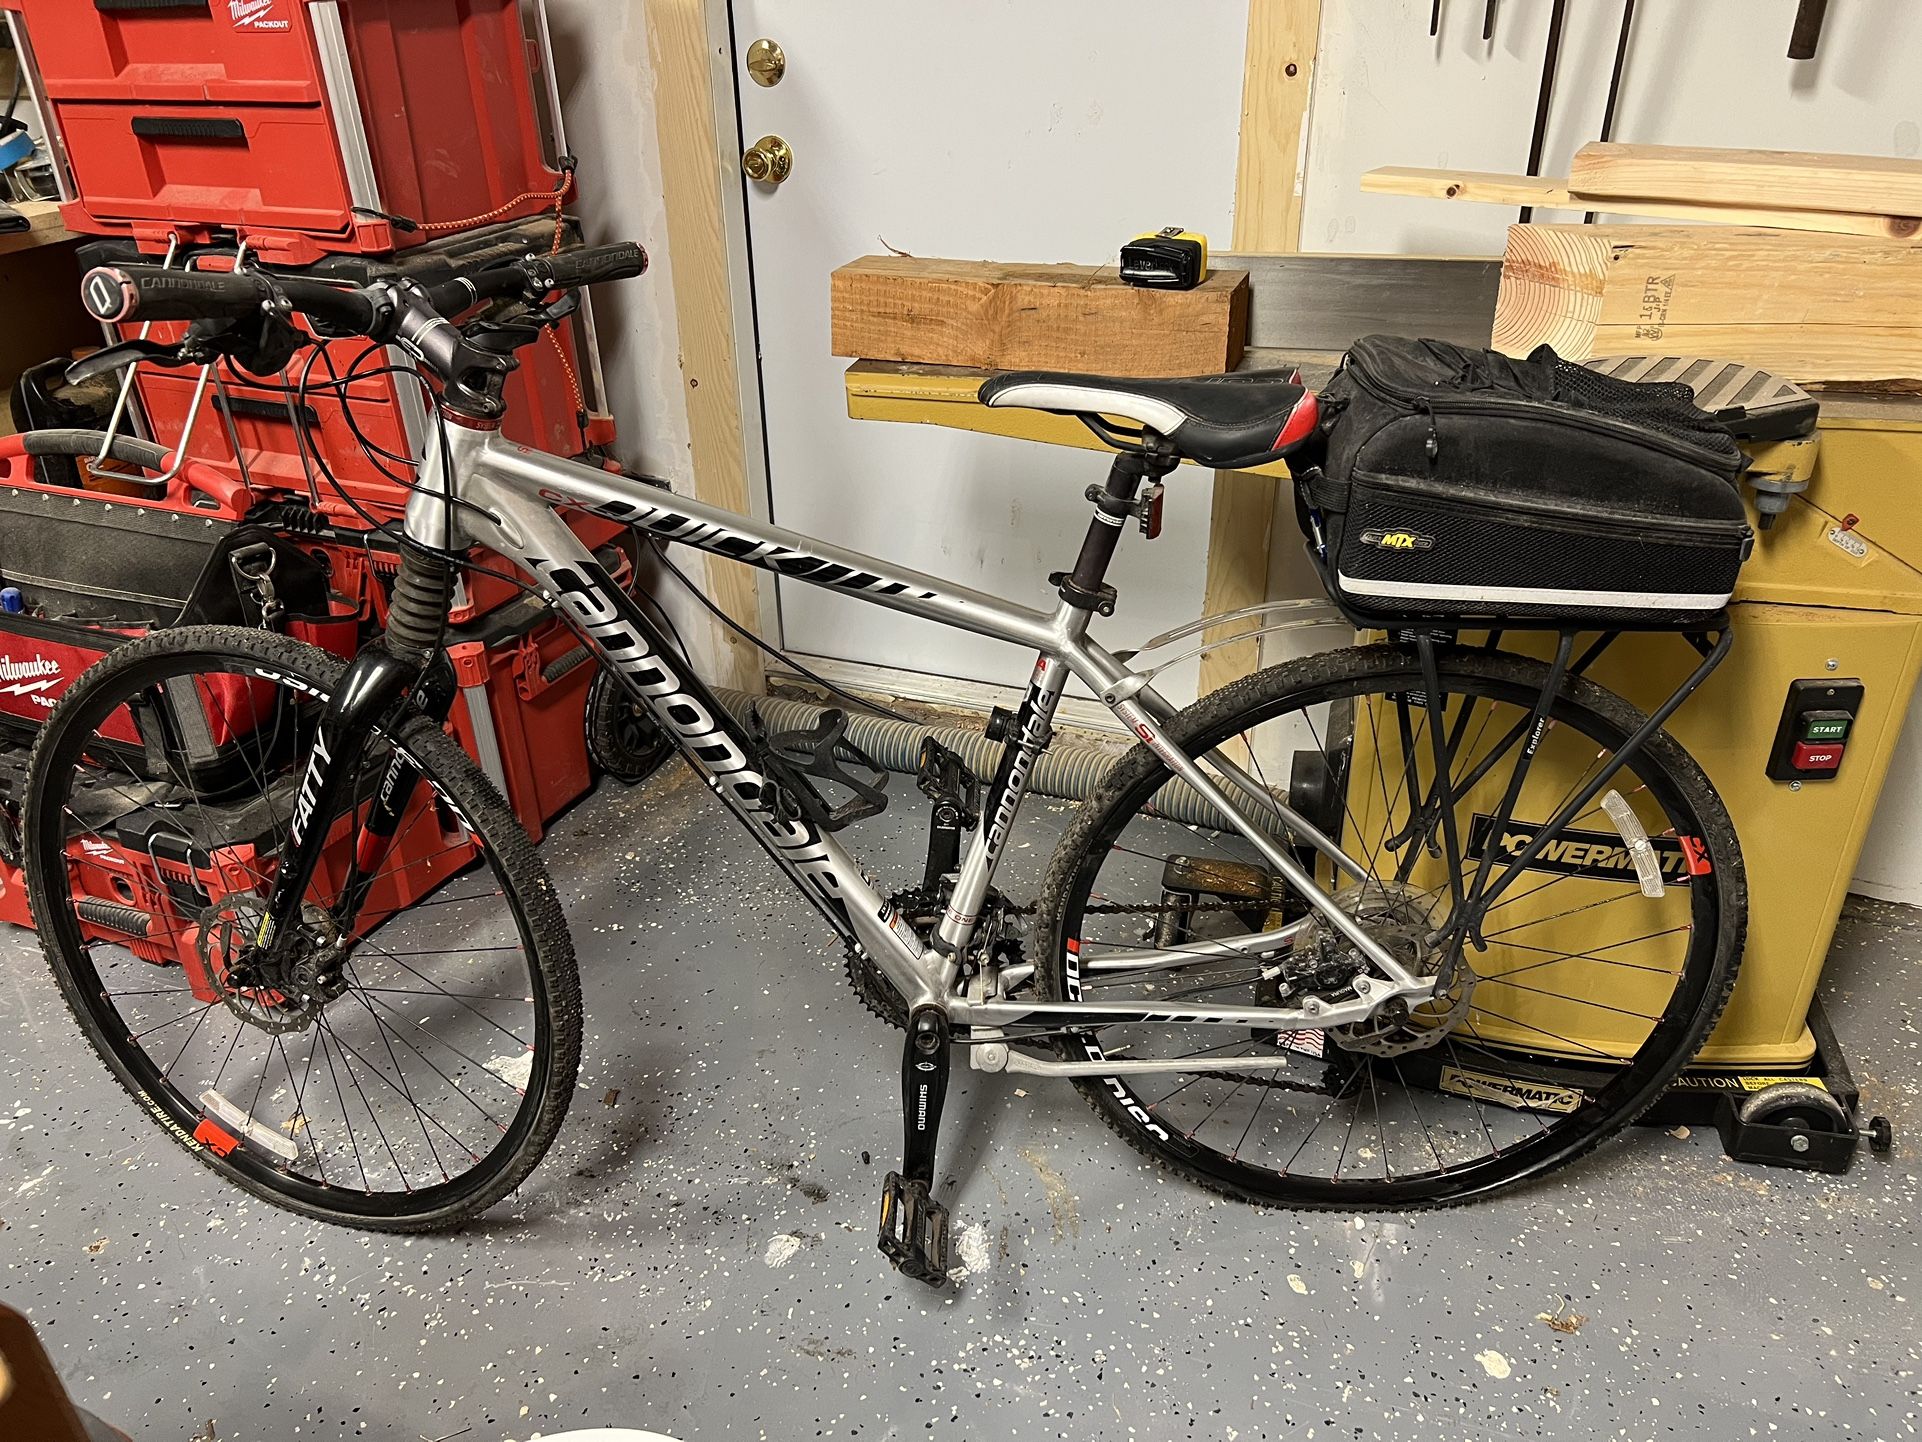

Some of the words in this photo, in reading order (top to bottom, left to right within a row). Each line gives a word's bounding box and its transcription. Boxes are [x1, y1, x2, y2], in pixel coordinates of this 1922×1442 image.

[253, 20, 289, 28] PACKOUT
[538, 488, 589, 509] CX
[1381, 533, 1417, 548] MTX
[0, 653, 61, 682] ilwaukee
[1526, 717, 1545, 755] Explorer
[1812, 726, 1843, 734] START
[1809, 754, 1833, 762] STOP
[292, 725, 331, 847] FATTY
[1672, 1077, 1740, 1089] AUTION
[917, 1084, 928, 1131] SHIMANO
[137, 1089, 205, 1152] KENDATIRE.COM
